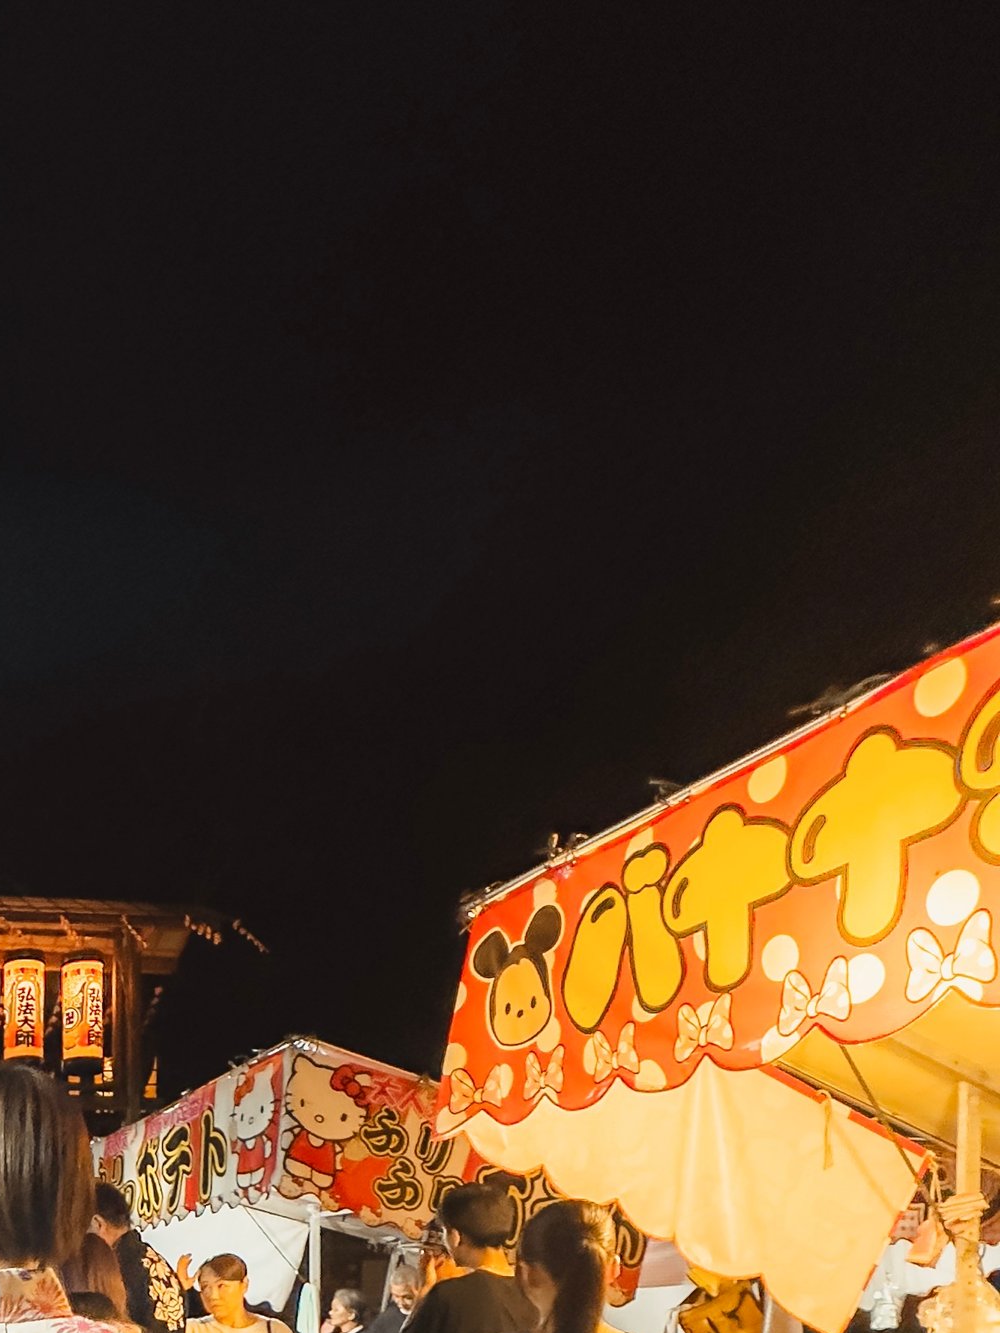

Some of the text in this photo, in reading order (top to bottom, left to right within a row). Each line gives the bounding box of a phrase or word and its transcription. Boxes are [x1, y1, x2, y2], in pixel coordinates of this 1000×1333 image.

[561, 677, 1000, 1034] バナナ
[15, 988, 36, 1047] 弘法大師
[87, 988, 103, 1046] 弘法大師
[136, 1107, 228, 1222] ポテト
